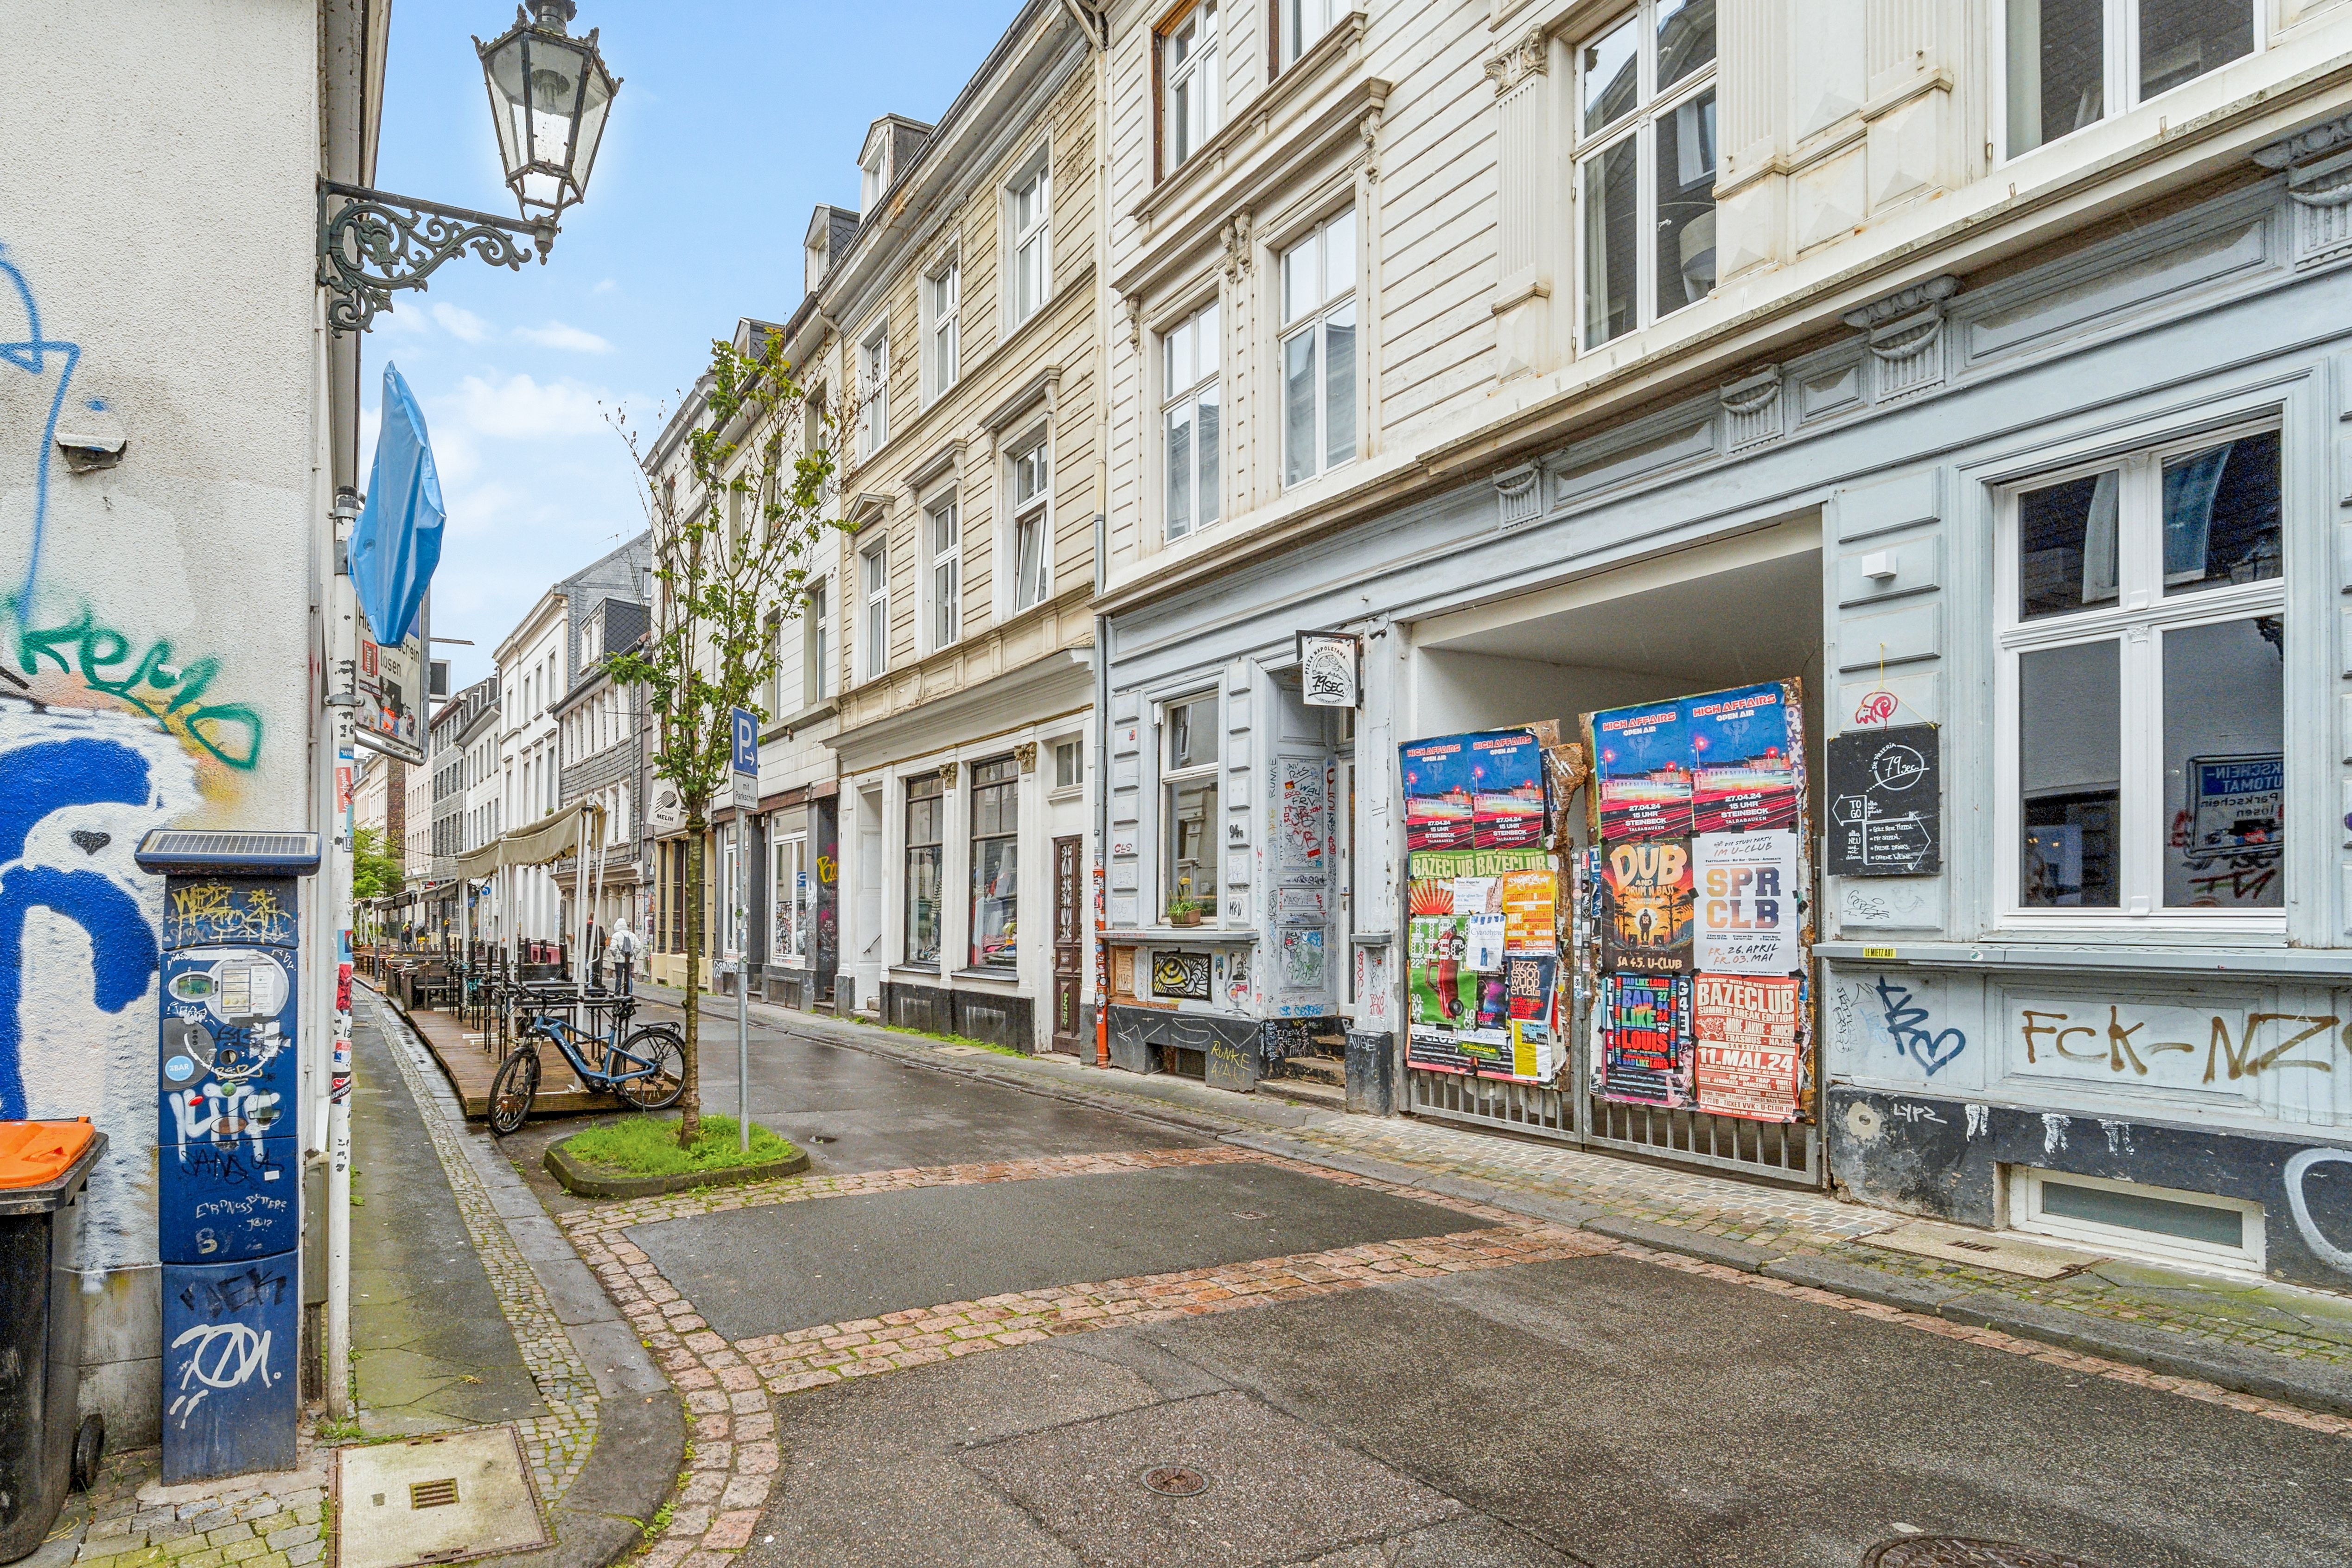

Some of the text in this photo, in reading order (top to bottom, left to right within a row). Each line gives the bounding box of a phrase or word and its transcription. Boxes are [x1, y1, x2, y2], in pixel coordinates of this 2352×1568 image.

[1305, 647, 1346, 674] PIZZA NAPOLETANA
[1693, 694, 1776, 717] HIGH AFFAIRS
[1603, 712, 1676, 732] HIGH AFFAIRS
[1716, 710, 1754, 722] OPEN AIR
[1643, 726, 1656, 734] AIR
[739, 717, 752, 764] P
[1473, 735, 1532, 750] HIGH AFFAIRS
[1407, 744, 1460, 757] HIGH AFFAIRS
[735, 790, 756, 803] Parkschein
[1725, 792, 1761, 802] 27.04.24
[1629, 803, 1661, 811] 27.04.24
[1849, 800, 1861, 809] TO
[1721, 808, 1768, 819] STEINBECK
[1850, 809, 1861, 818] GO
[1625, 817, 1666, 827] STEINBECK
[1714, 842, 1772, 857] IM U-CLUB
[1412, 857, 1475, 878] BAZECLUB
[1476, 855, 1547, 877] BAZECLUB
[1610, 843, 1687, 892] DUB
[1706, 867, 1781, 897] SPR
[1625, 885, 1674, 895] DRUM N BASS
[1706, 899, 1779, 929] CLB
[1708, 943, 1779, 956] FR. 26. APRIL
[1617, 956, 1683, 970] SA 4.5. U-CLUB
[1714, 953, 1773, 965] FR. 03. MAI
[1635, 978, 1649, 987] LIKE
[1650, 979, 1669, 987] LOUIS
[1411, 994, 1423, 1003] 30.
[1622, 989, 1654, 1008] BAD
[1697, 983, 1794, 1014] BAZECLUB
[1622, 1008, 1657, 1029] LIKE
[1657, 1011, 1668, 1021] 24
[1698, 1006, 1794, 1022] SUMMER BREAK EDITION
[1726, 1017, 1743, 1033] MORE
[1744, 1020, 1765, 1034] JAKKIE
[1348, 1035, 1376, 1052] AUGE
[1622, 1030, 1668, 1052] LOUIS
[1726, 1034, 1761, 1044] ERASMUS
[558, 1038, 576, 1061] FLYER
[1211, 1040, 1251, 1071] RUNKE
[1623, 1058, 1669, 1069] BAD LIKE LOUIS
[1698, 1048, 1793, 1072] 11.MAI.24
[1714, 1077, 1738, 1085] AFROBEATS
[1761, 1104, 1793, 1113] U-CLUB.DE
